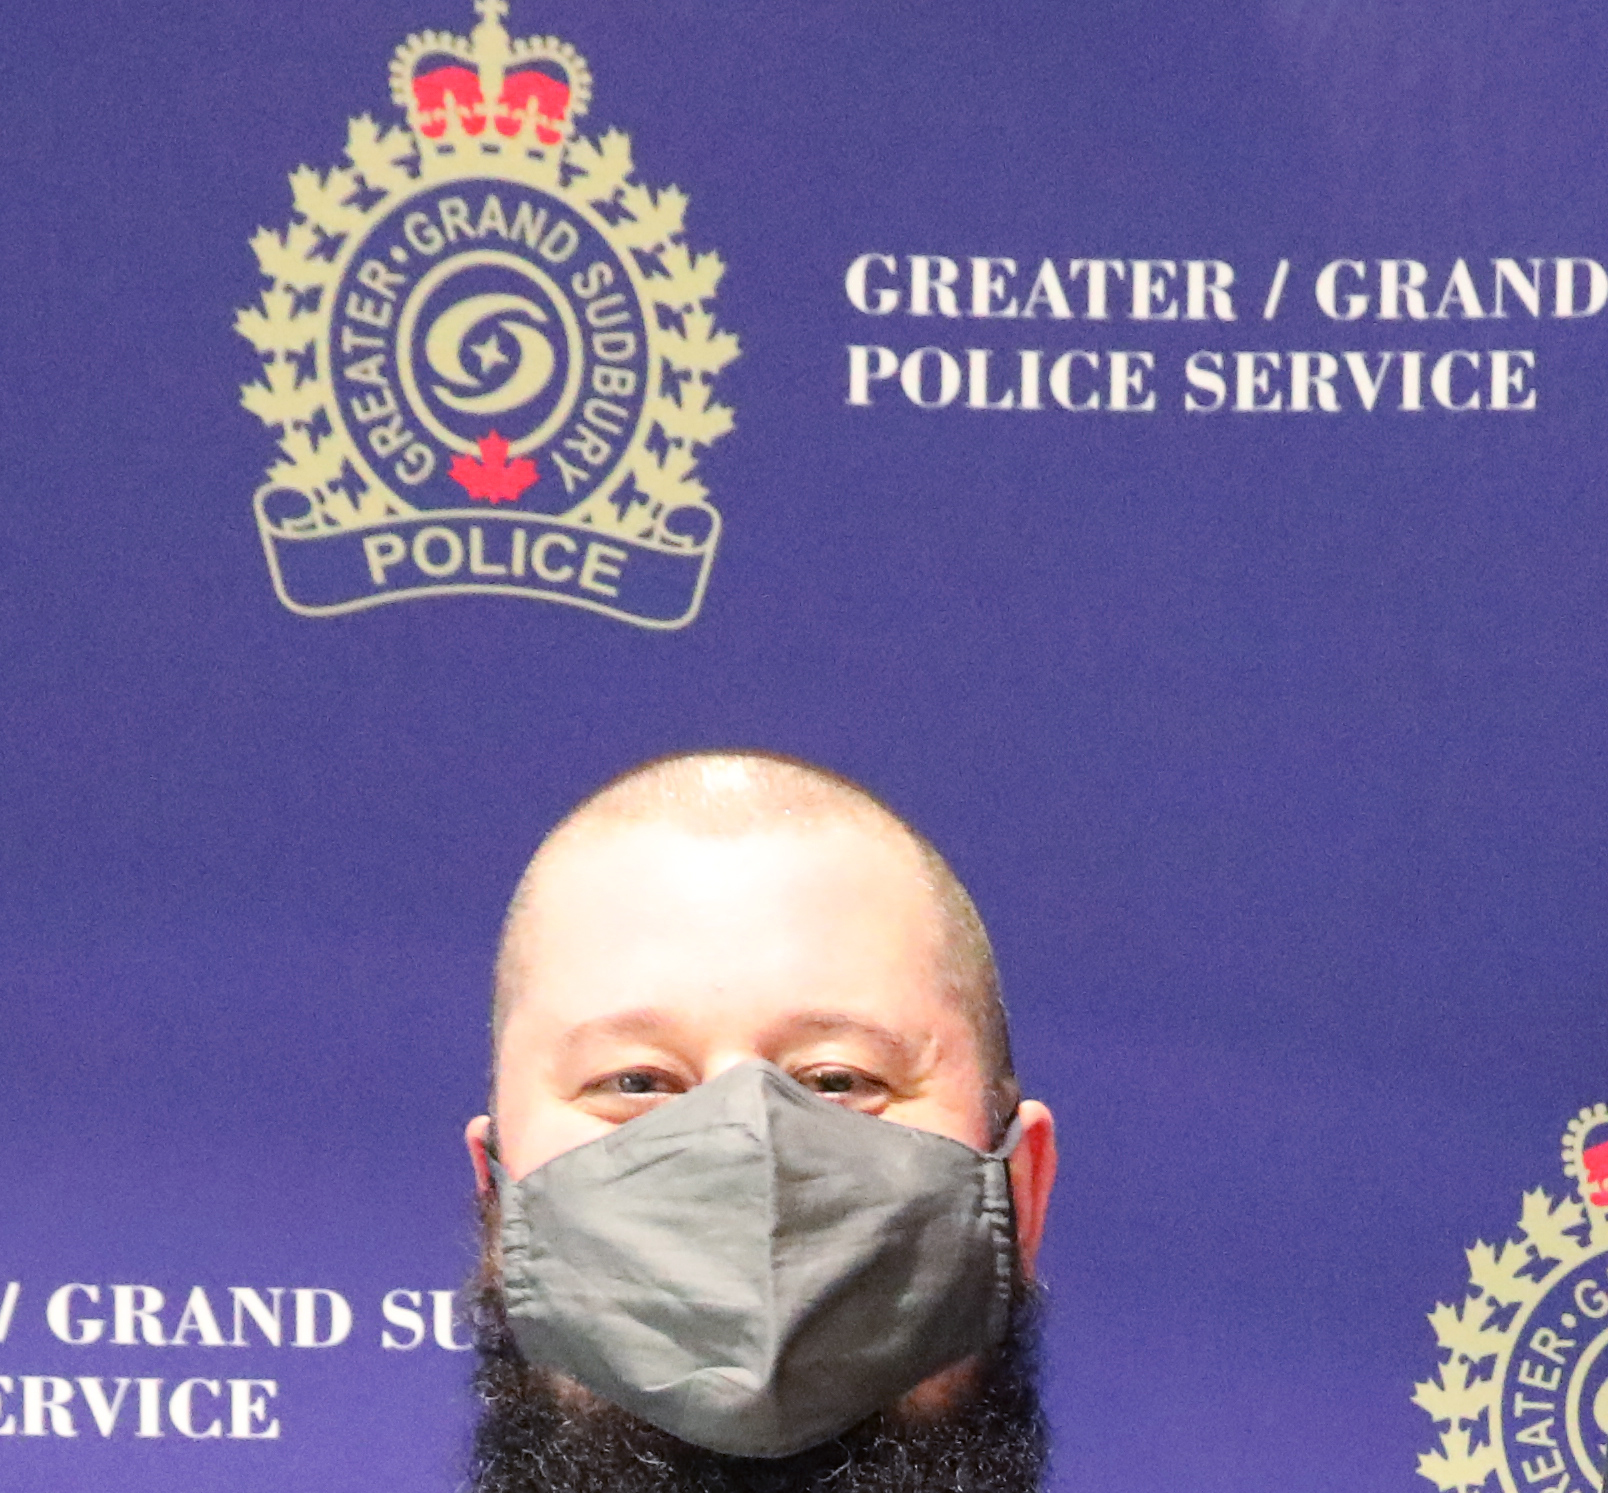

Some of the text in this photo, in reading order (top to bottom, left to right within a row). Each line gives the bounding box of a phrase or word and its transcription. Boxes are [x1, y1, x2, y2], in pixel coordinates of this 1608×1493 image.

[845, 253, 1236, 321] GREATER
[1264, 259, 1289, 320] /
[1315, 257, 1608, 320] GRAND
[342, 193, 636, 493] GREATER GRAND SUDBURY
[848, 345, 1536, 412] POLICE SERVICE
[362, 526, 627, 597] POLICE
[46, 1283, 352, 1348] GRAND
